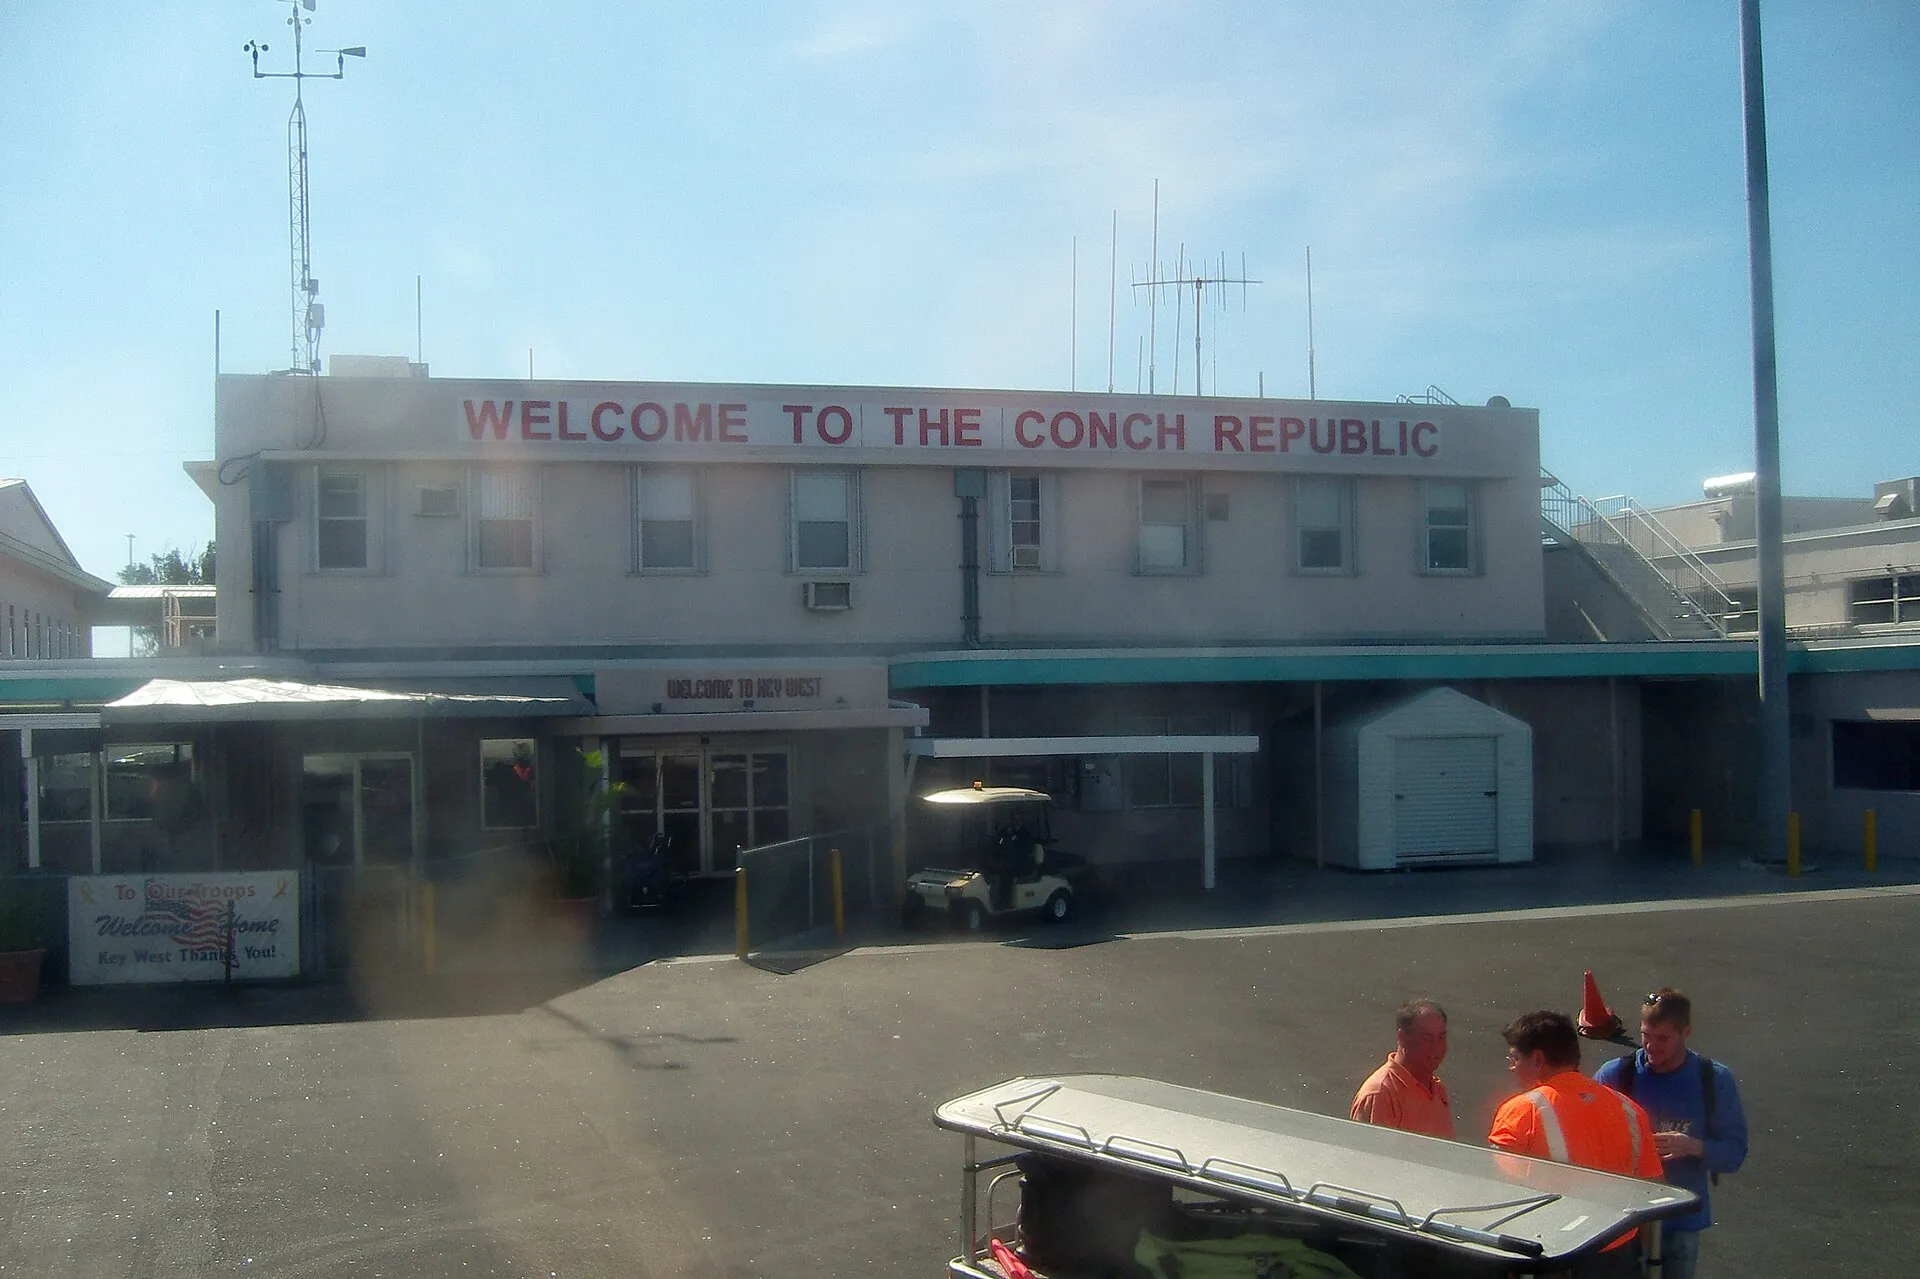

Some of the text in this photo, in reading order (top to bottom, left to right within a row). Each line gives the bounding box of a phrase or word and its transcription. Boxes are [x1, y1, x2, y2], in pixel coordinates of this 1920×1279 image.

[463, 400, 1439, 458] WELCOME TO THE CONCH REPUBLIC
[667, 677, 823, 699] WELCOME TO KEY WEST
[115, 882, 256, 900] To Our Troops
[96, 914, 193, 937] Welcome
[98, 951, 126, 966] Key
[133, 949, 172, 963] West
[244, 945, 276, 960] You!
